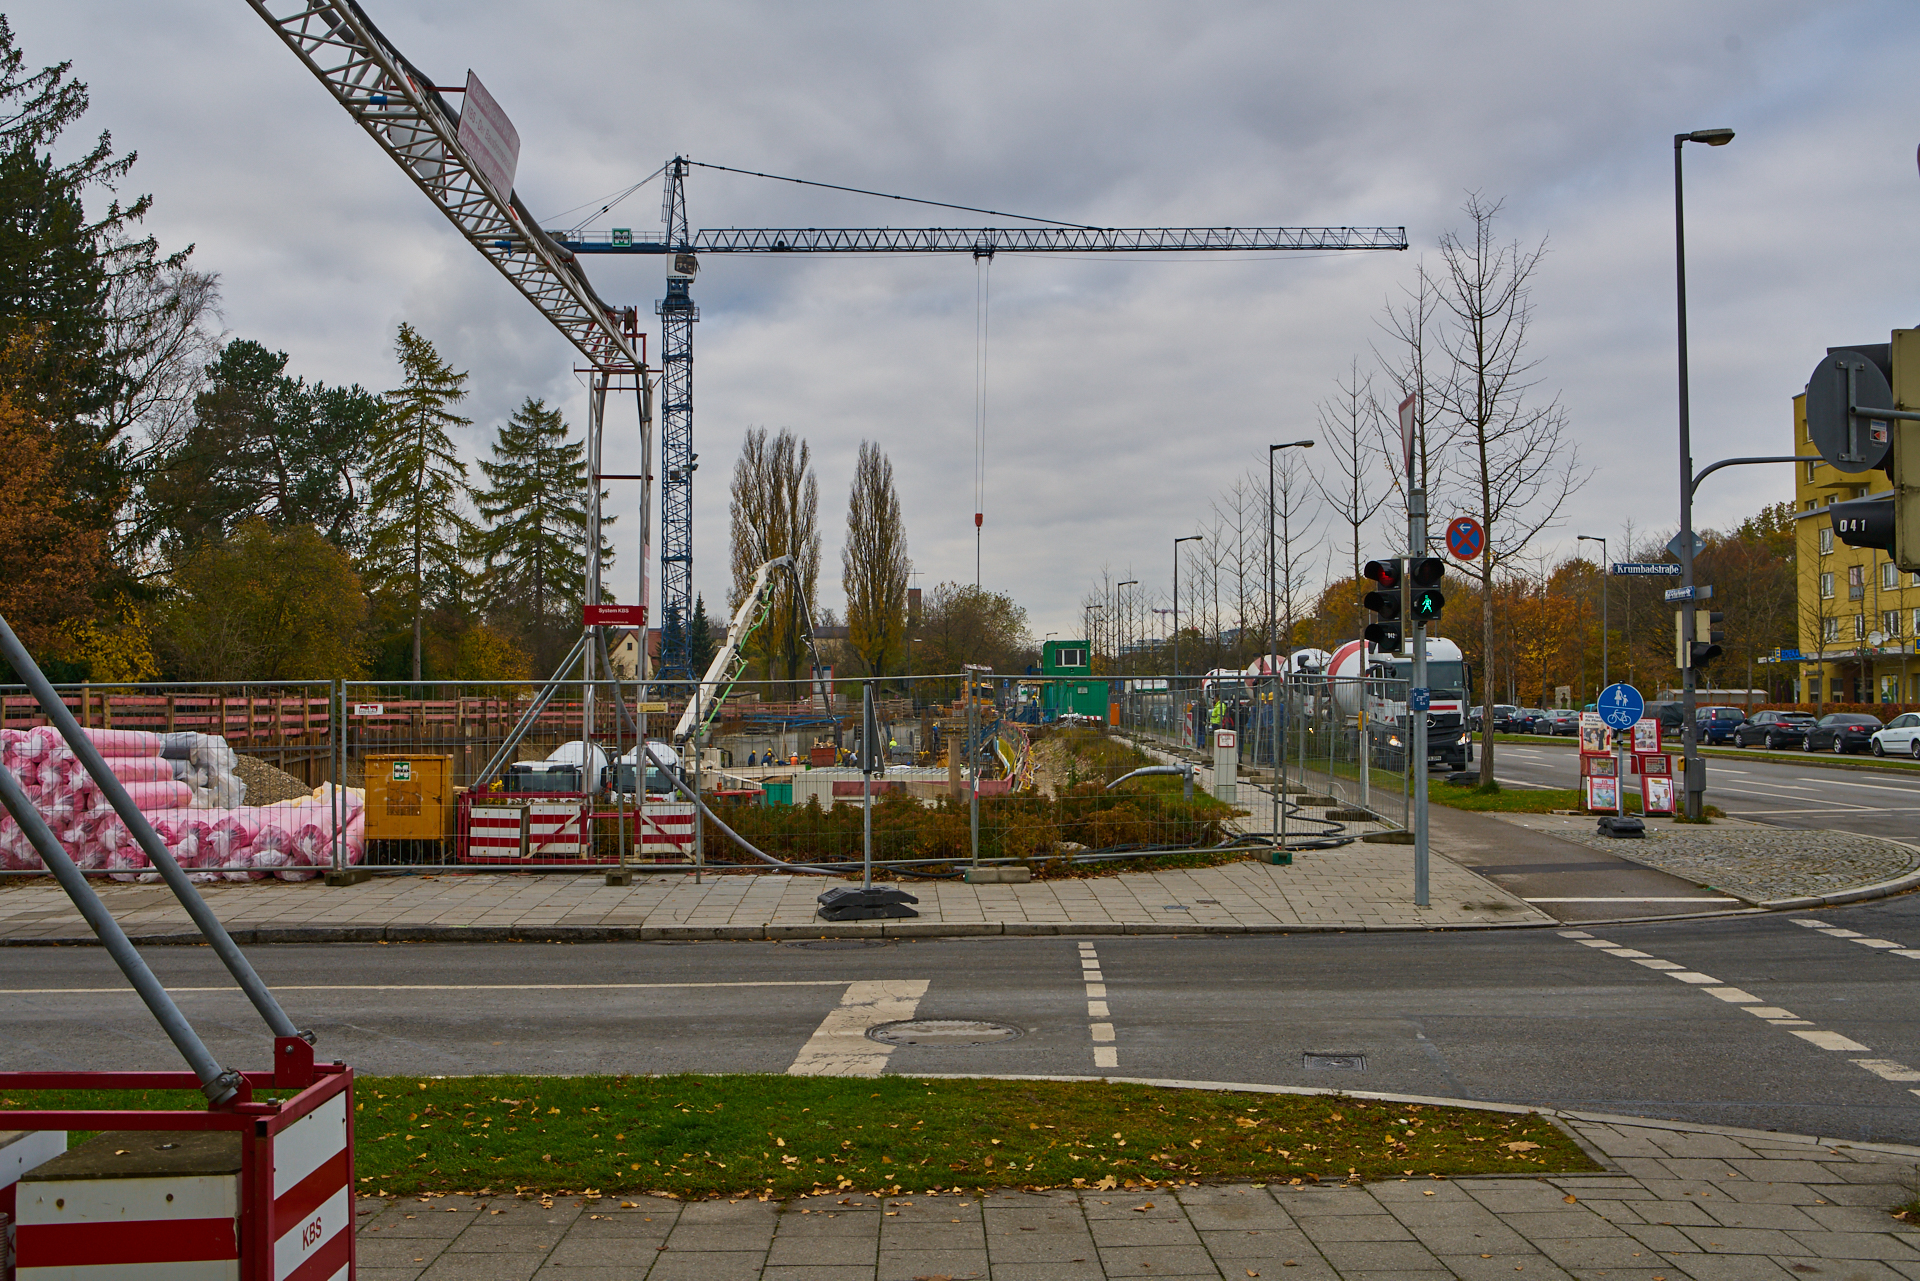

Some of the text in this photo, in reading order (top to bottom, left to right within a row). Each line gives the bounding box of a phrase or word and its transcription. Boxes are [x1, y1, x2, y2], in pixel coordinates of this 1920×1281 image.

[466, 104, 476, 124] KBS
[1839, 519, 1866, 532] 041
[1617, 564, 1679, 575] Krumbadstraße
[1781, 649, 1800, 658] EDEKA
[303, 1216, 322, 1251] KBS
